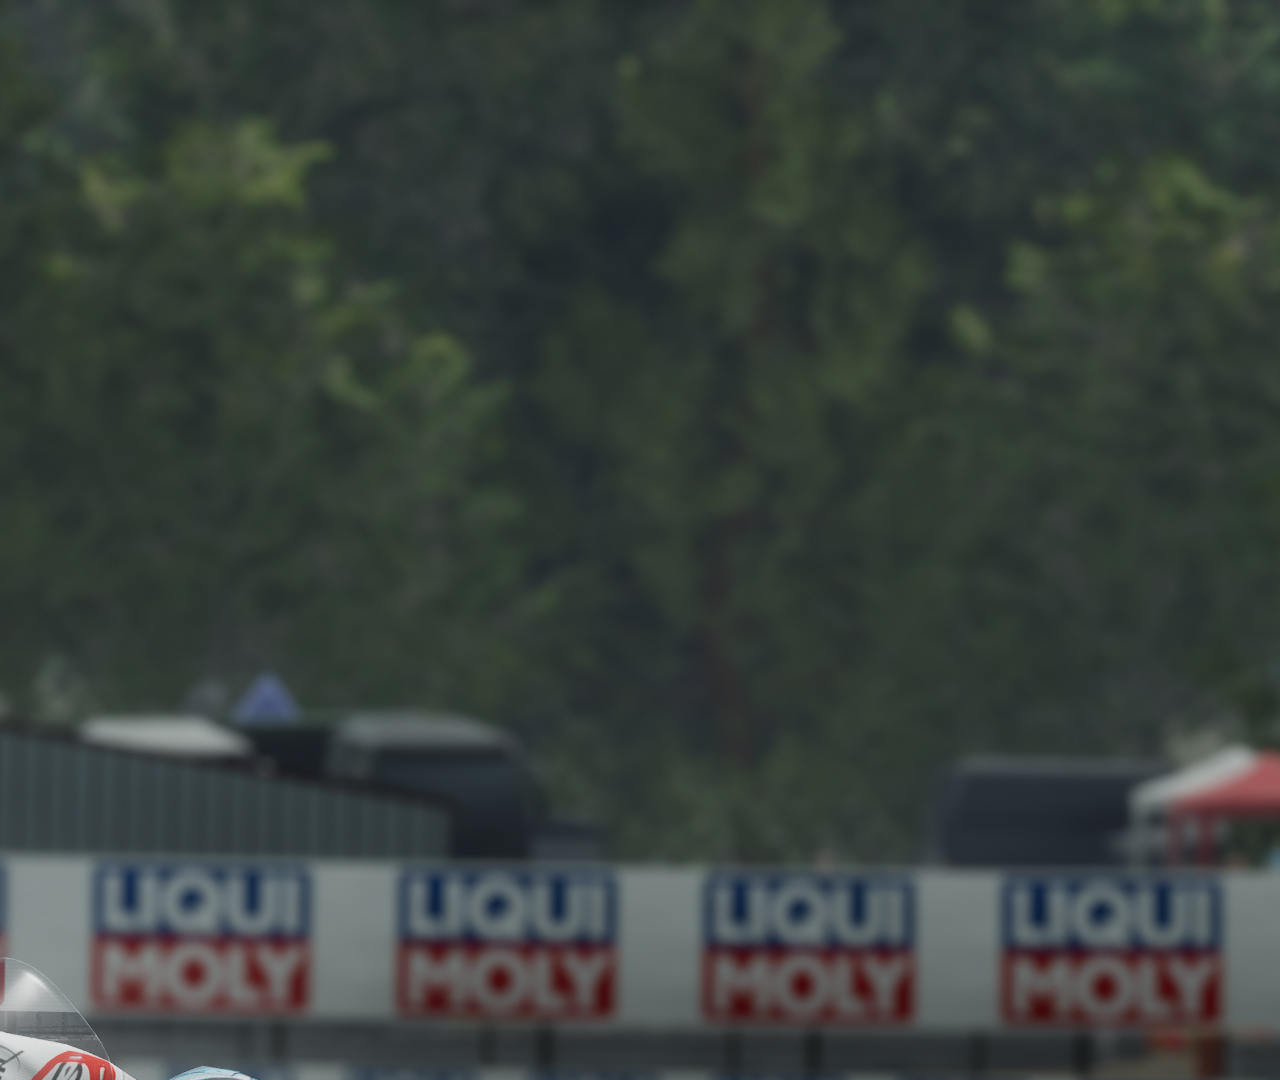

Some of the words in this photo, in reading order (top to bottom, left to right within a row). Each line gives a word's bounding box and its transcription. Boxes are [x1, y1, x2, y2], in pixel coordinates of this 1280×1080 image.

[104, 871, 307, 934] LIQUI
[410, 872, 609, 938] LIQUI
[714, 877, 908, 945] LIQUI
[1014, 880, 1215, 945] LIQUI
[102, 943, 307, 1003] MOLY
[405, 947, 612, 1007] MOLY
[717, 953, 911, 1012] MOLY
[1017, 955, 1219, 1015] MOLY
